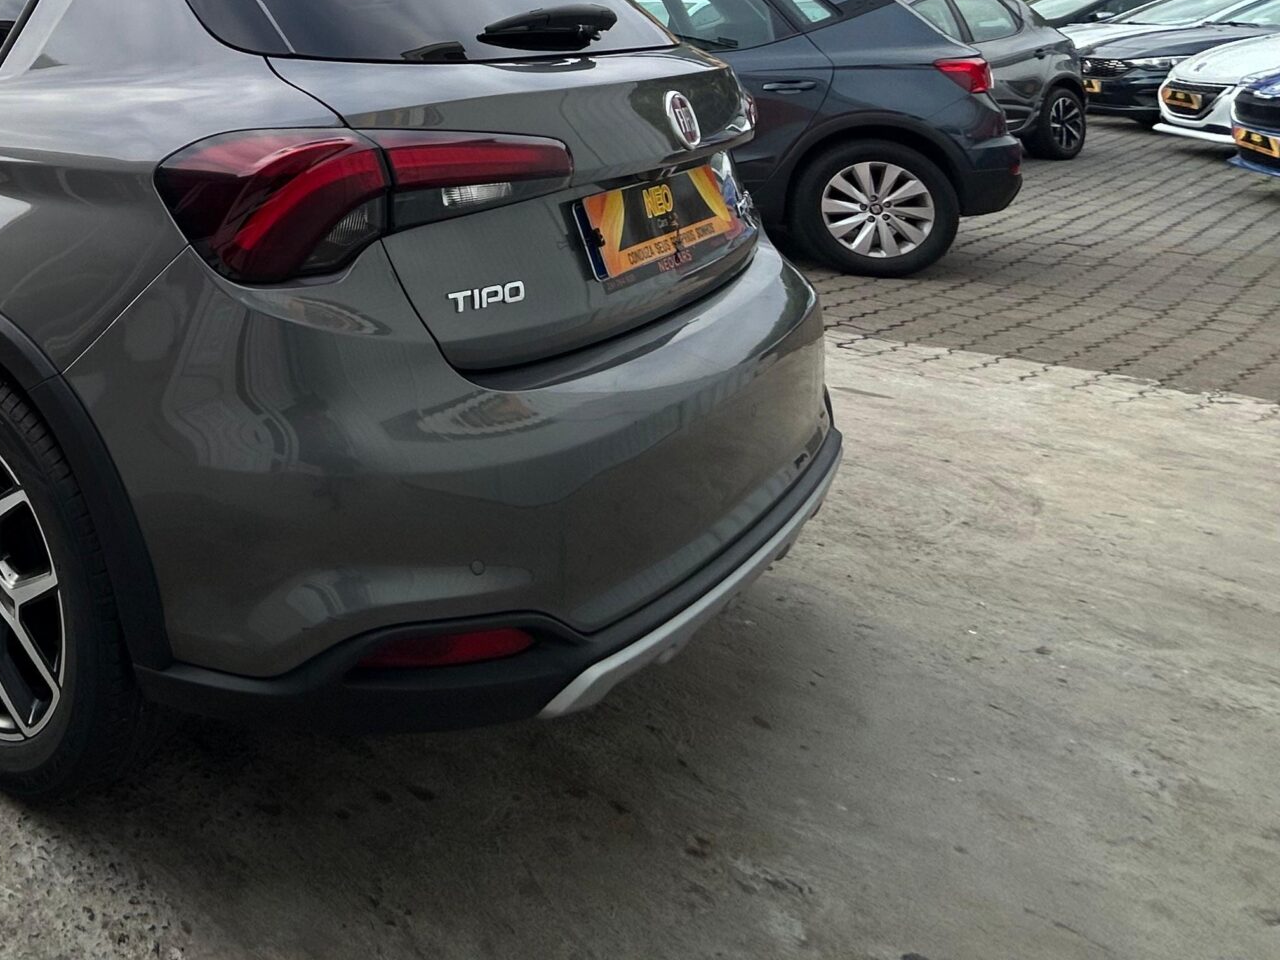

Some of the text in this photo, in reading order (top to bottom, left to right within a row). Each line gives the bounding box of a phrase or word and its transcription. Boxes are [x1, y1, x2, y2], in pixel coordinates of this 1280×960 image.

[642, 184, 673, 219] NEO
[627, 245, 655, 265] CONDUZA
[447, 280, 525, 313] TIPO
